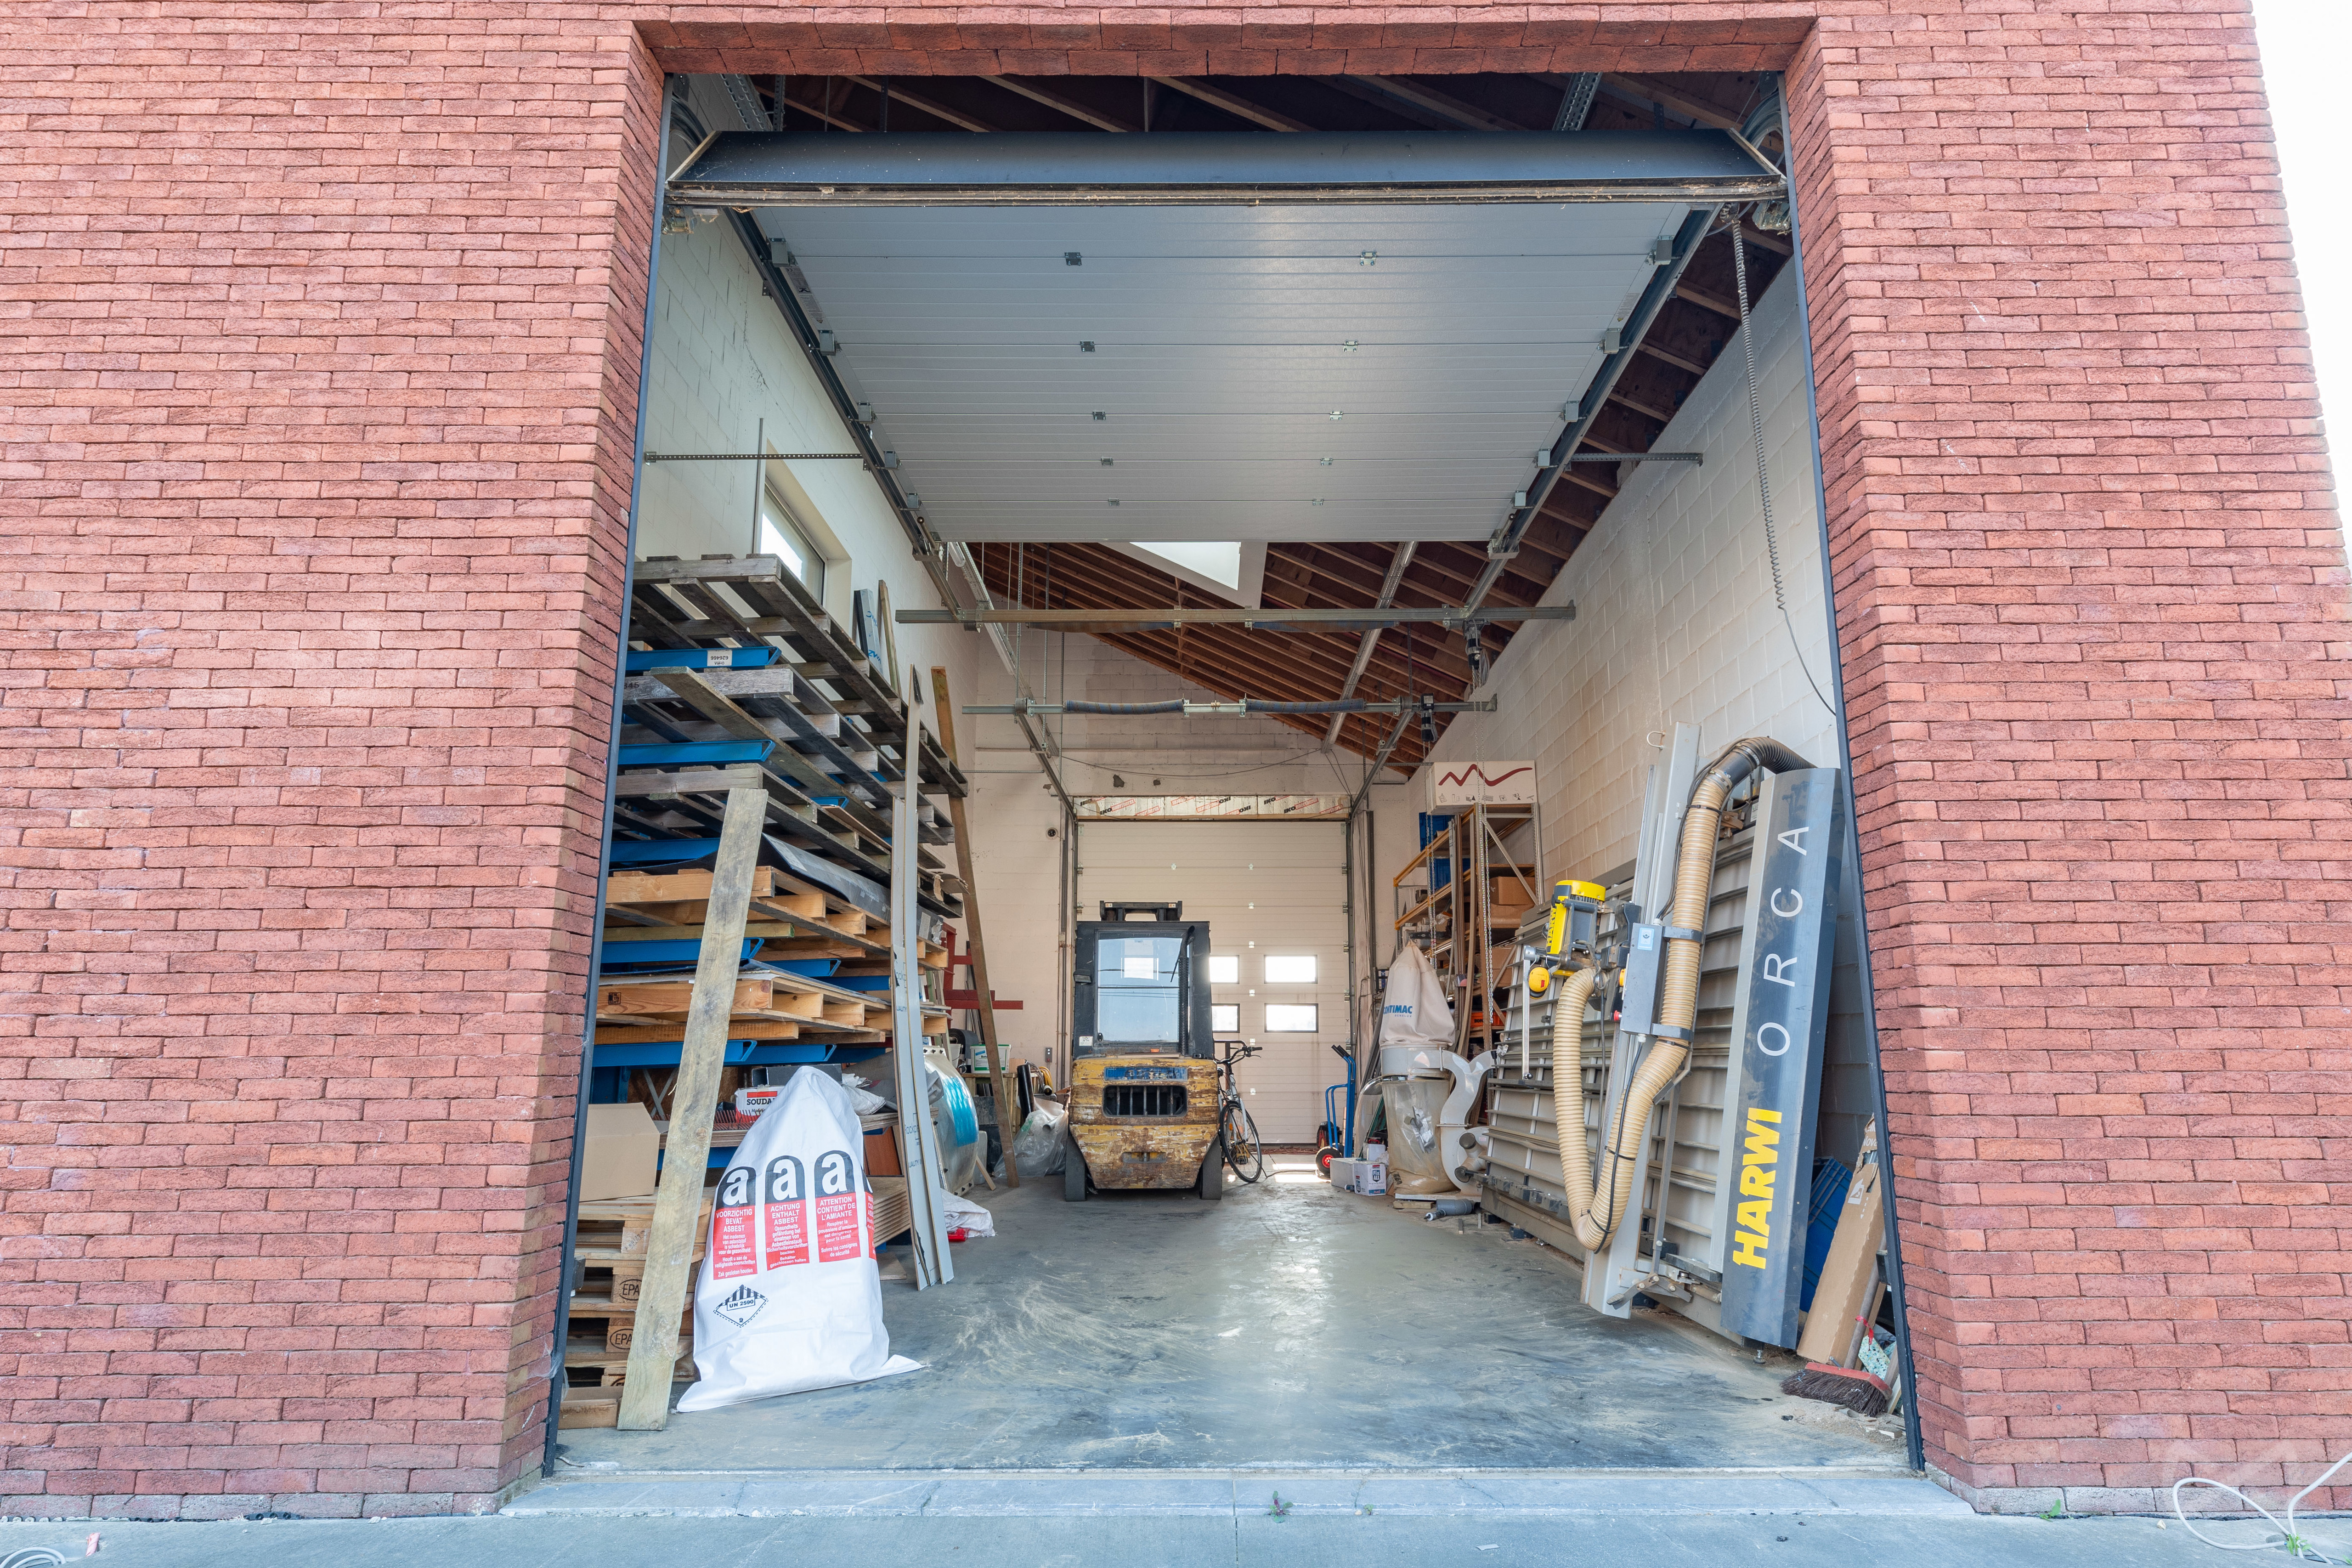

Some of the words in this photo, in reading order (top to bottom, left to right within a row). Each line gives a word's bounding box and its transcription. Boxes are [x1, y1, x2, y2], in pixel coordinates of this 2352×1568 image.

[1284, 806, 1296, 814] IKO
[1296, 798, 1317, 809] enertherm
[1100, 807, 1112, 815] IKO
[1732, 1107, 1782, 1269] HARWI
[1757, 826, 1809, 1056] ORCA
[820, 1196, 852, 1206] ATTENTION
[770, 1203, 800, 1212] ACHTUNG
[817, 1204, 846, 1214] CONTIENT
[717, 1209, 752, 1218] VOORZICHTIG
[772, 1210, 799, 1218] ENTHALT
[821, 1210, 852, 1221] L'AMIANTE
[774, 1217, 798, 1225] ASBEST
[839, 1242, 858, 1251] consignes
[770, 1260, 794, 1268] geschlossen
